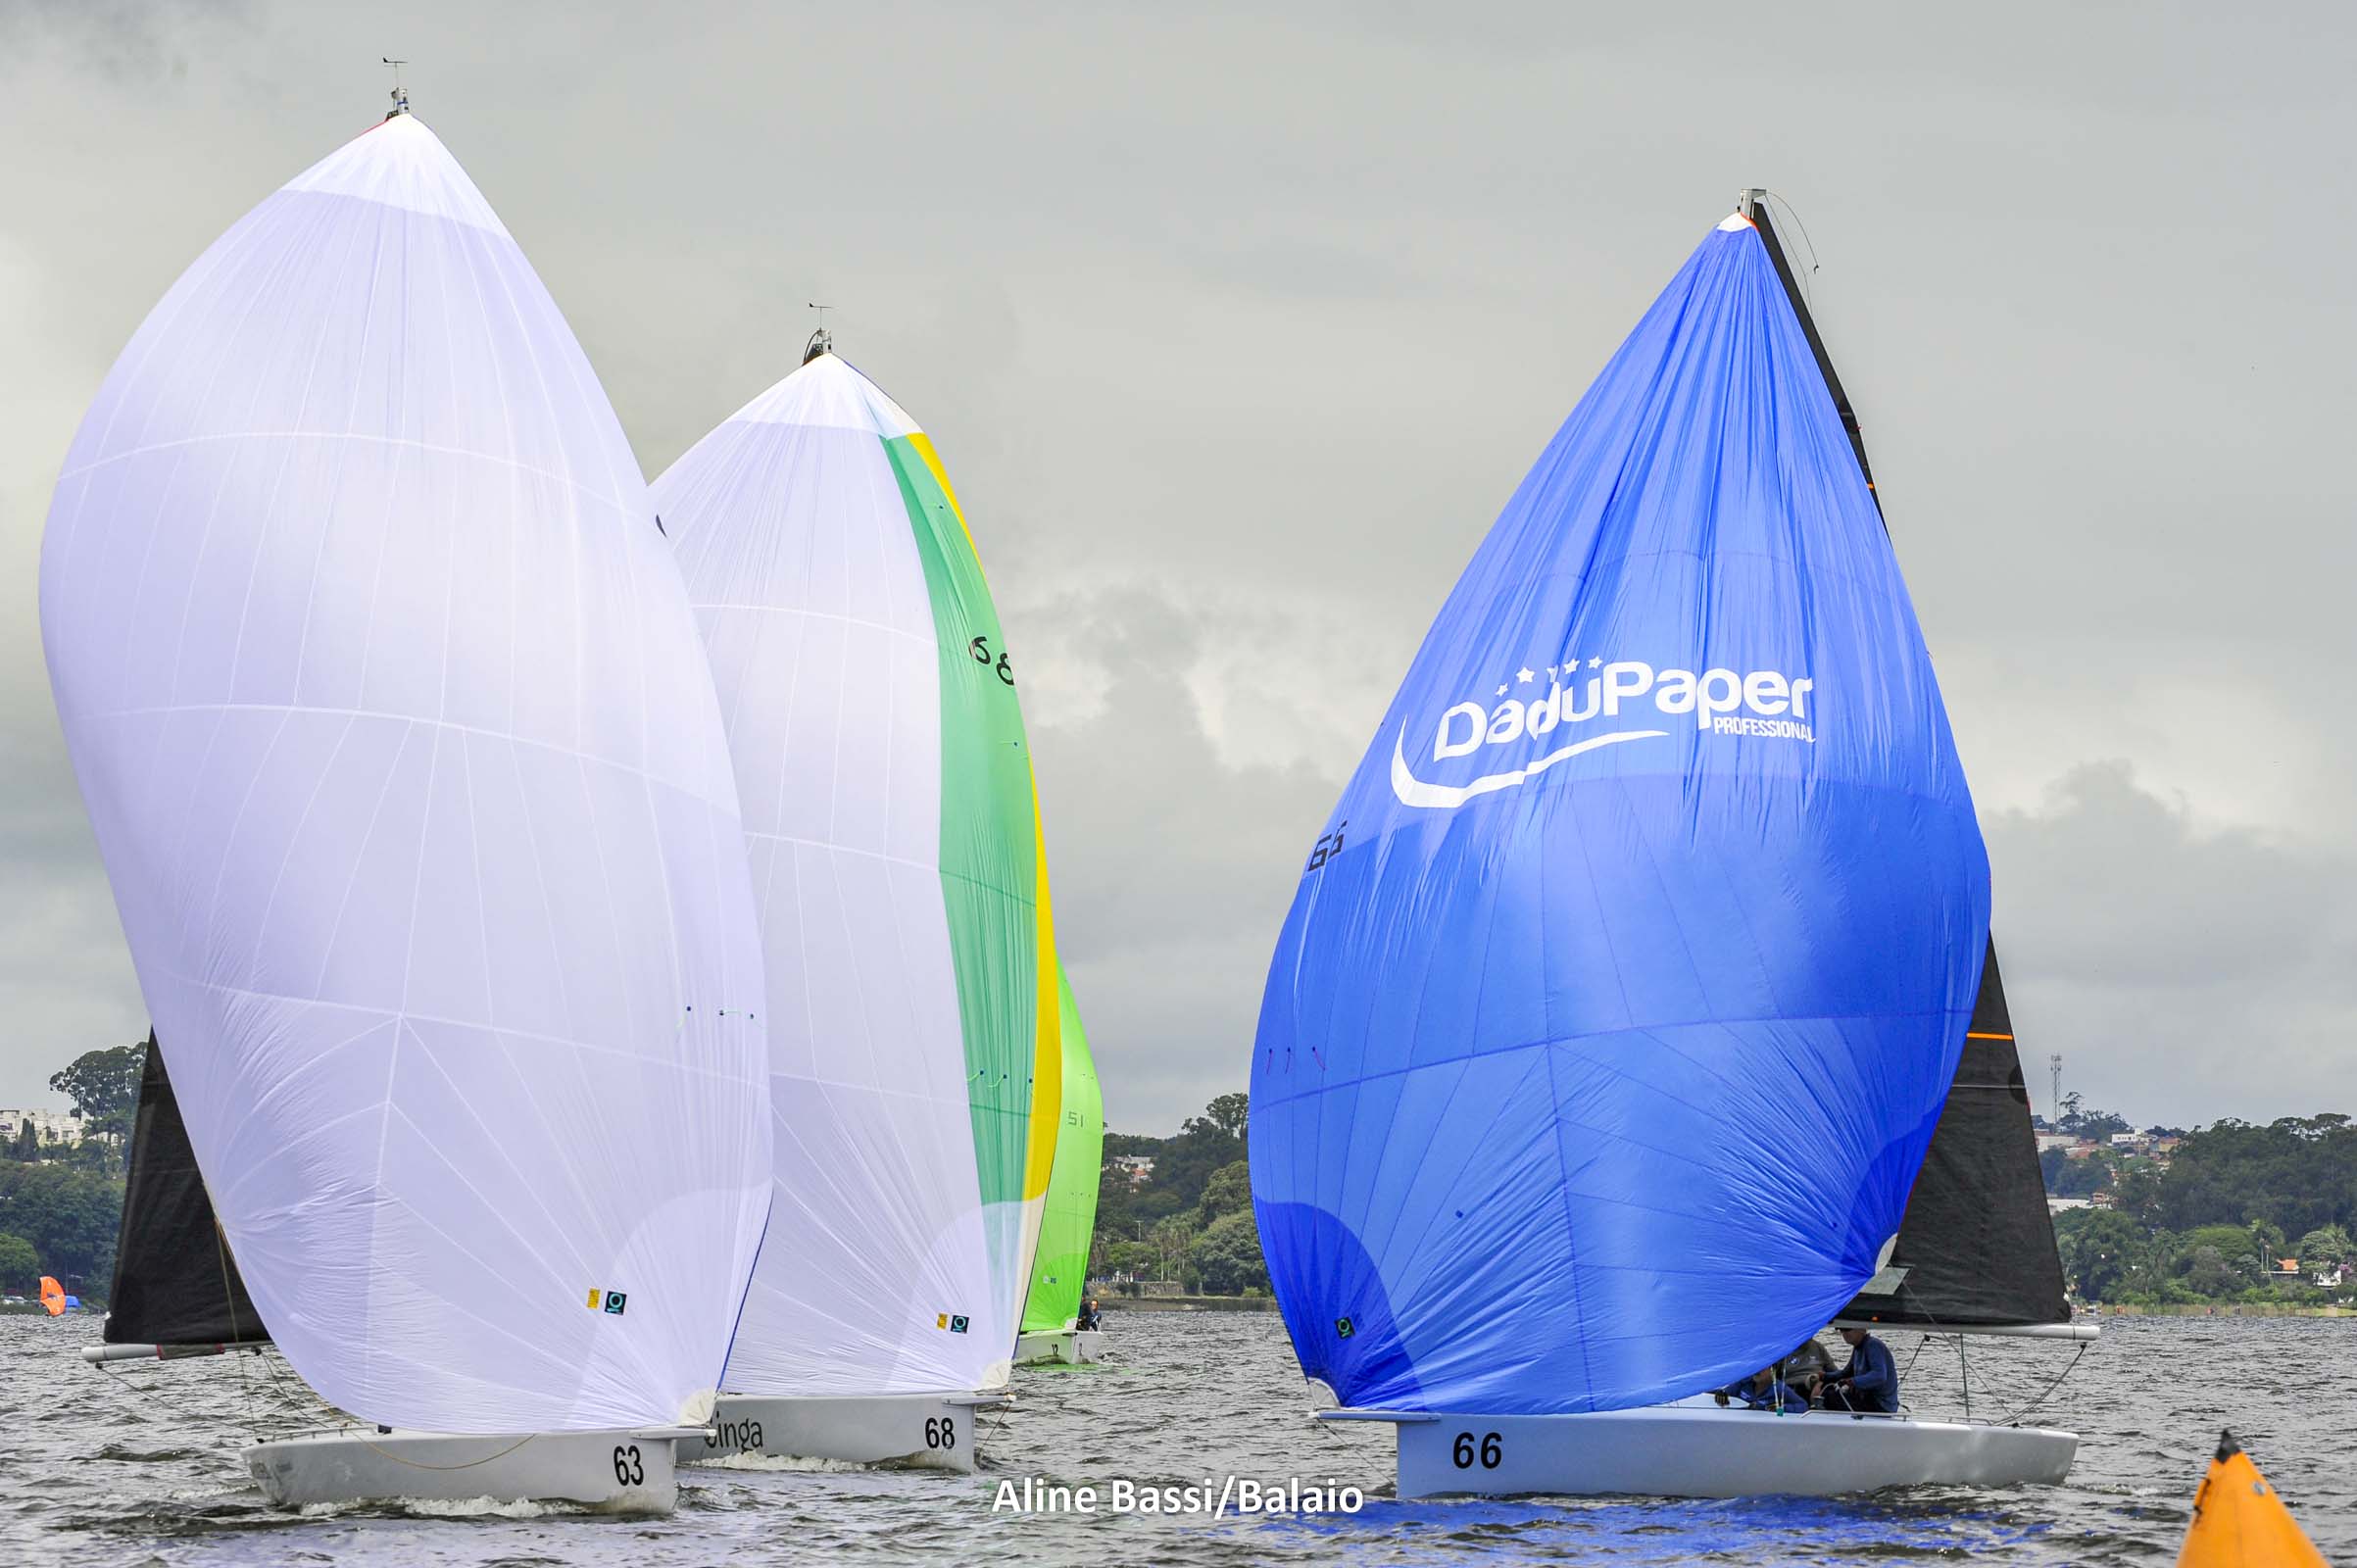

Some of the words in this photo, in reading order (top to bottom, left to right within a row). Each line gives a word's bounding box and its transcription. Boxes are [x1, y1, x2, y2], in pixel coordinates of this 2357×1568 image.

[968, 636, 1014, 685] 68
[1714, 716, 1816, 743] PROFESSIONAL
[1308, 820, 1348, 871] 66
[925, 1417, 956, 1449] 68
[1453, 1432, 1502, 1469] 66
[614, 1446, 644, 1486] 63
